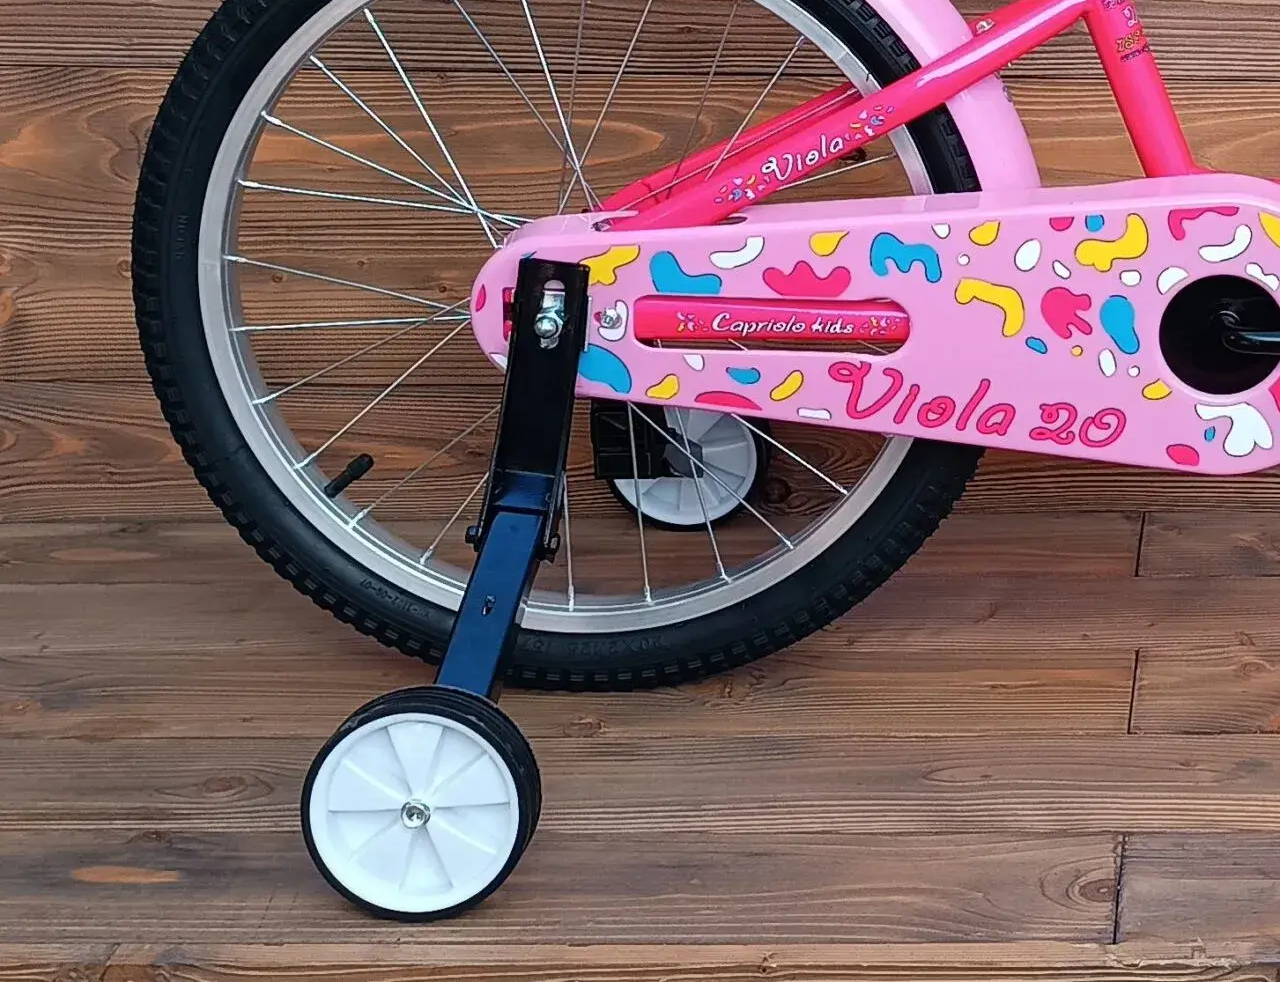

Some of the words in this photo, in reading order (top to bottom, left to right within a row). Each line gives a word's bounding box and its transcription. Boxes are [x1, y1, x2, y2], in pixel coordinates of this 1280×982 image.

[761, 134, 844, 181] Viola
[712, 312, 806, 338] Capriolo
[811, 316, 854, 335] kids
[828, 360, 1016, 436] Viola
[1028, 402, 1127, 448] 20
